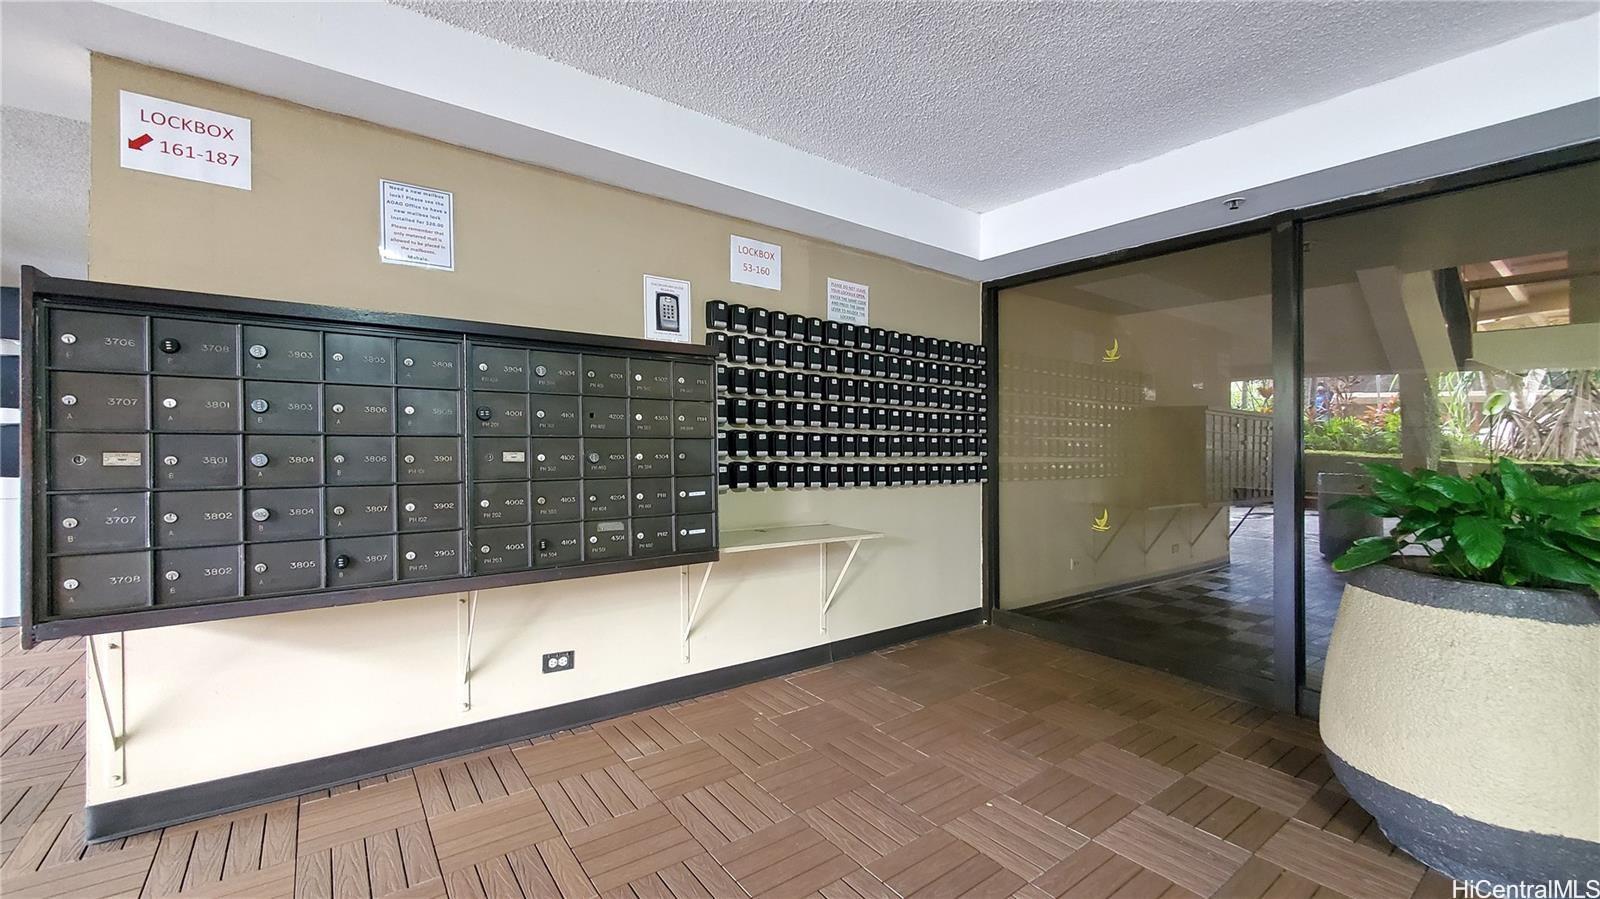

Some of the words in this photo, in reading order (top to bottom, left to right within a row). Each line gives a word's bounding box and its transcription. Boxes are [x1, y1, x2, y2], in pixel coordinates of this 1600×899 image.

[140, 109, 234, 141] LOCKBOX
[160, 140, 240, 168] 161-187
[738, 246, 775, 260] LOCKBOX
[743, 263, 770, 276] 53-160
[104, 337, 136, 347] 3706
[107, 398, 138, 406] 3707
[105, 516, 136, 524] 3707
[204, 512, 232, 520] 3802
[290, 561, 316, 569] 3805
[204, 567, 232, 576] 3802
[109, 576, 141, 584] 3708
